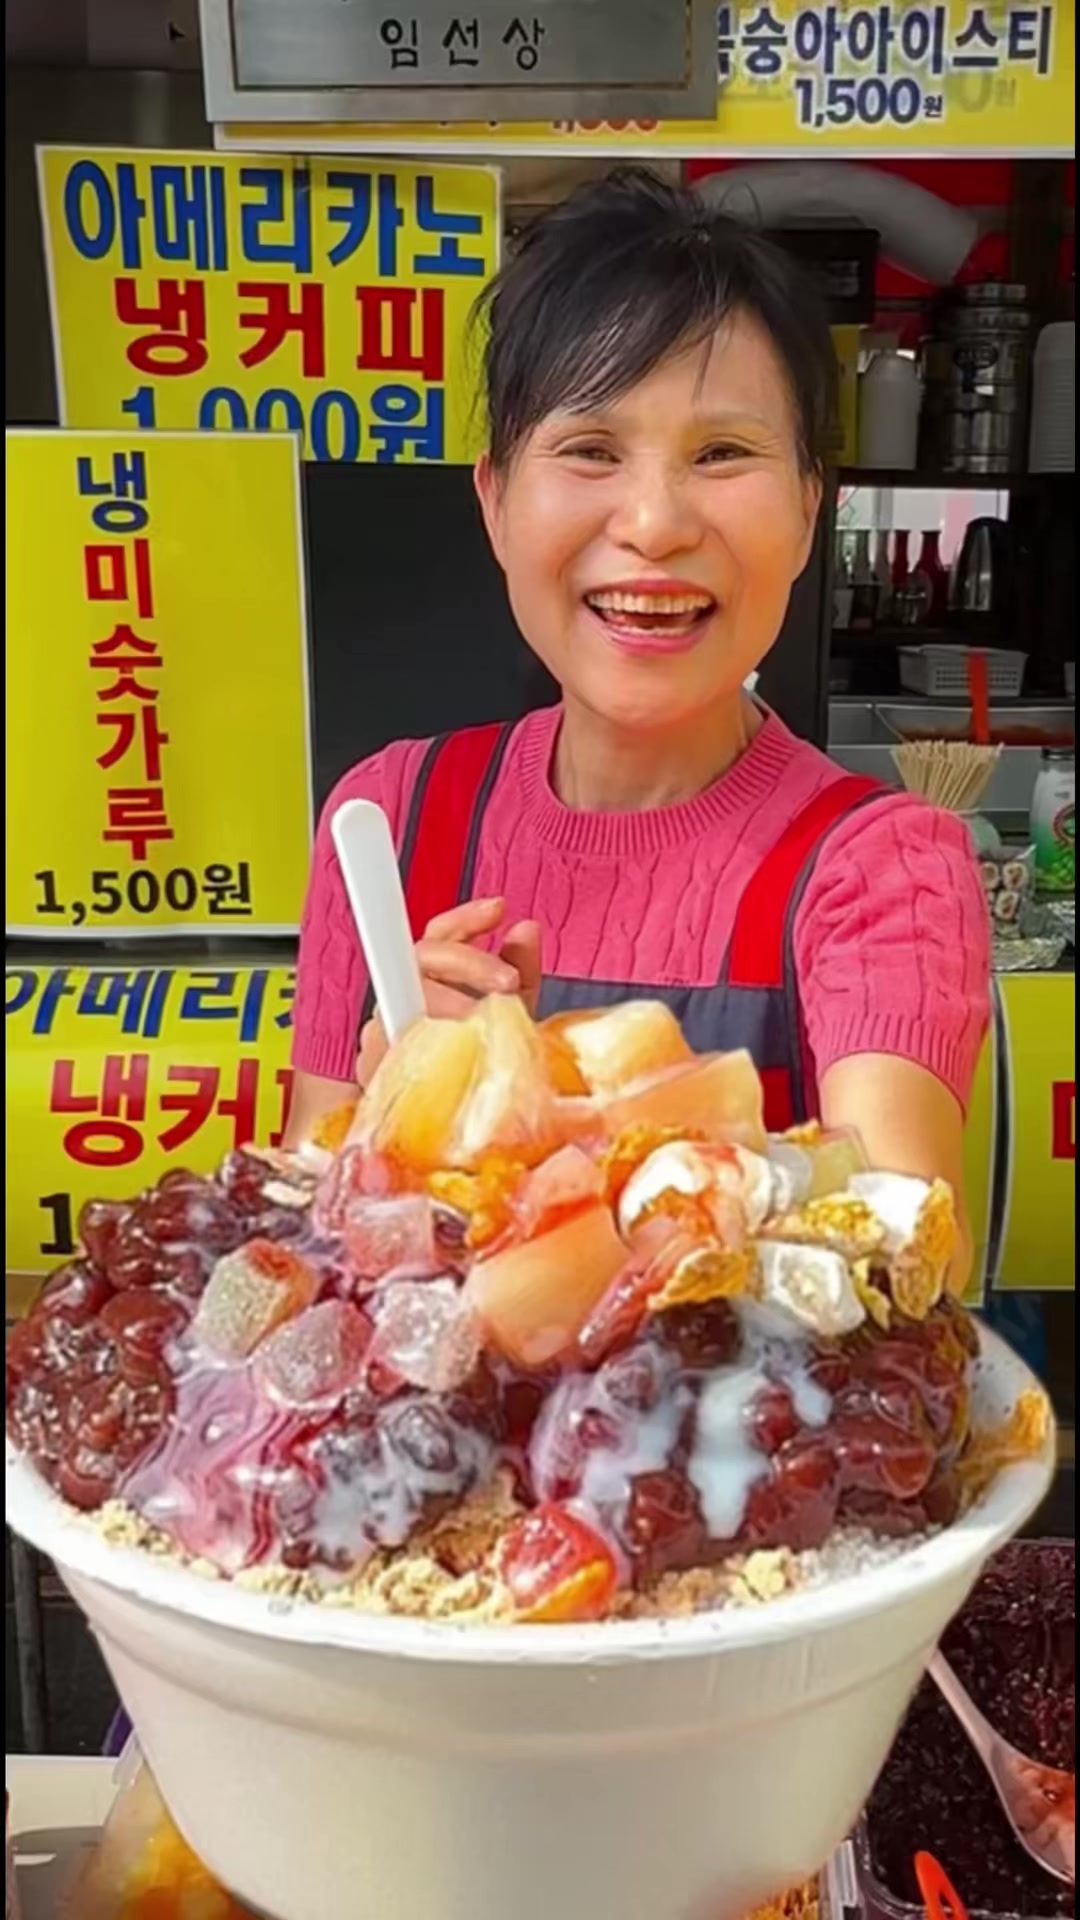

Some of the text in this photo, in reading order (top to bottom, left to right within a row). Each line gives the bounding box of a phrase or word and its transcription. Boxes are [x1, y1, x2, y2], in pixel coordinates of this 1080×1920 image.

[380, 18, 546, 70] 임선상
[794, 78, 943, 127] 1,500원
[64, 160, 485, 277] 아메리카노
[114, 278, 445, 382] 냉커피
[122, 384, 445, 463] 1000원
[34, 862, 253, 925] 1,500원
[50, 1053, 294, 1167] 냉커
